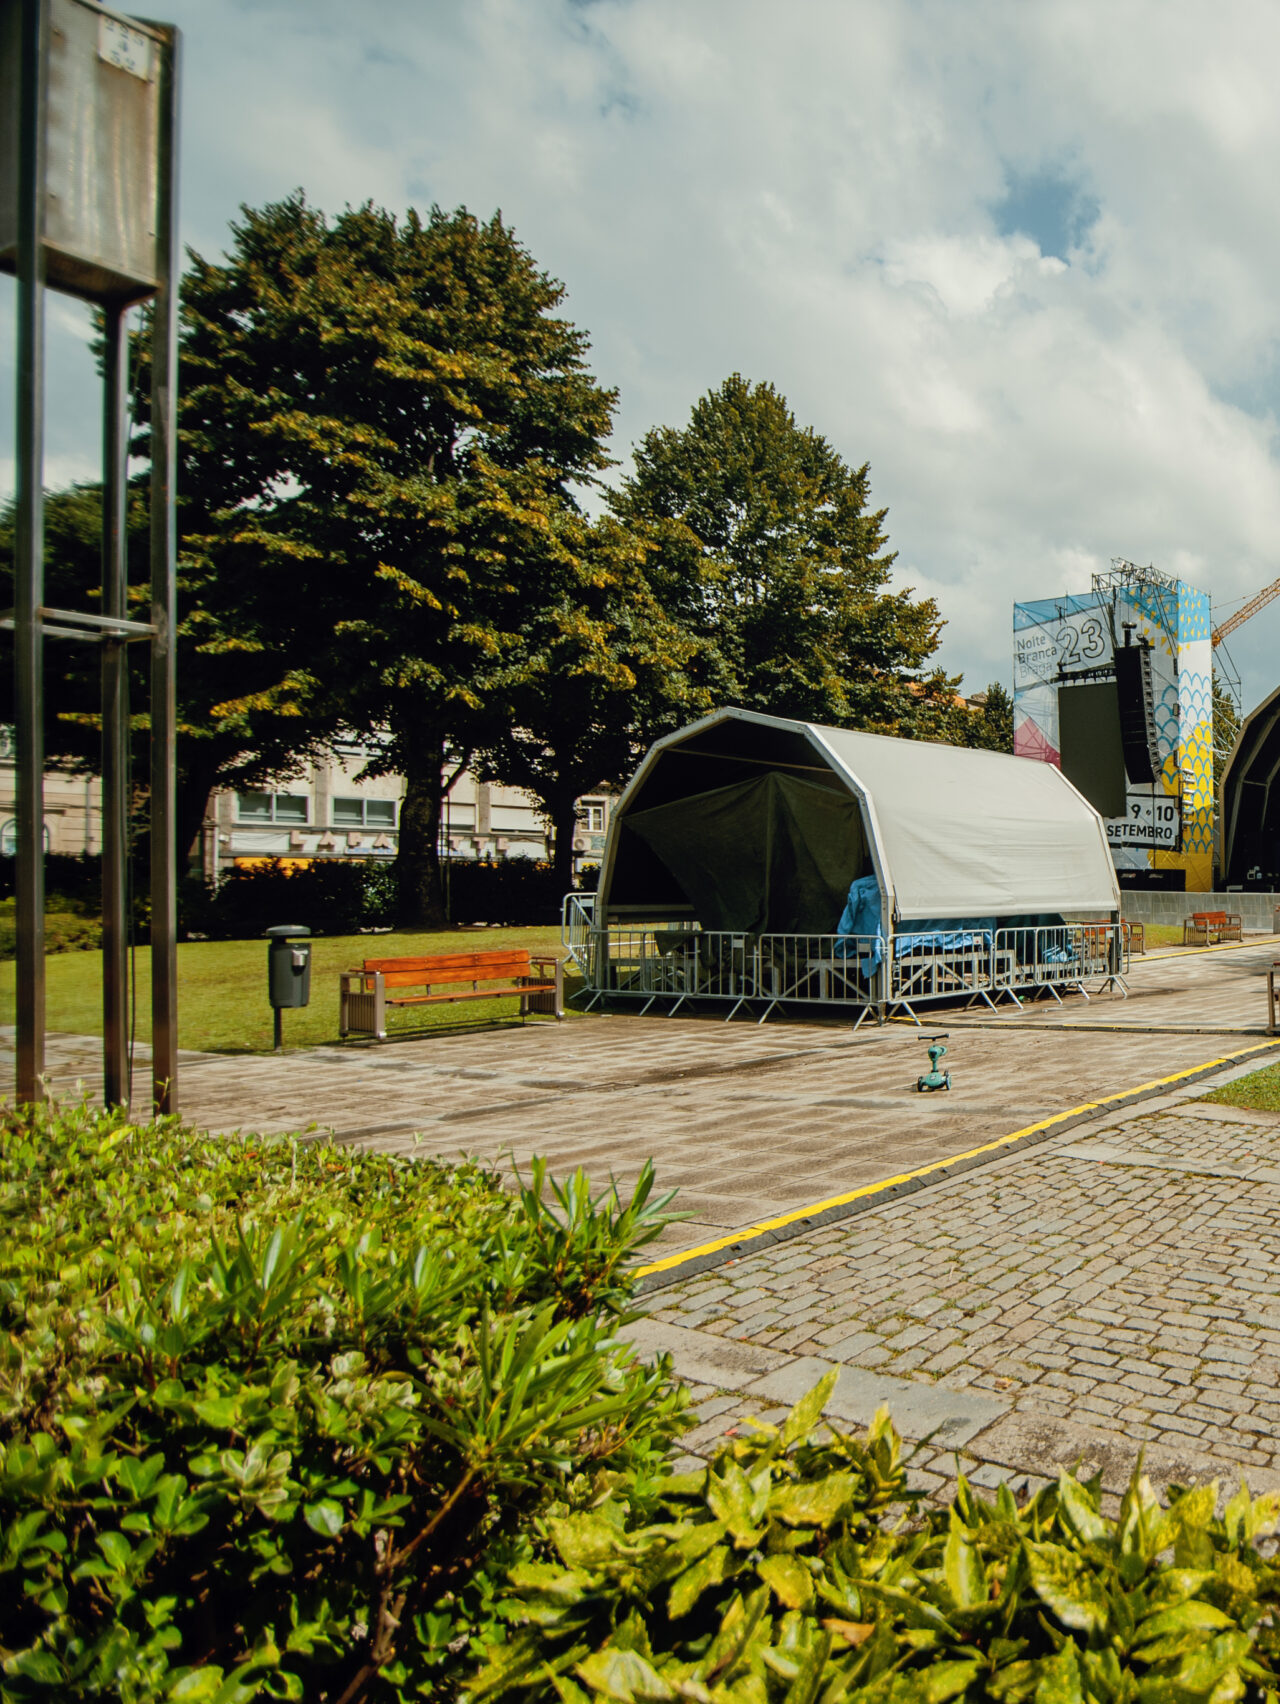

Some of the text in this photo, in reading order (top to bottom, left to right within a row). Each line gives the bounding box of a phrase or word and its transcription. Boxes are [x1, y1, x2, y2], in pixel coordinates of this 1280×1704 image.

[1017, 635, 1046, 651] Noite
[1056, 618, 1105, 666] 23
[1017, 646, 1057, 664] Branca
[1020, 662, 1053, 678] Braga
[1131, 804, 1174, 822] 9 10
[1107, 824, 1173, 839] SETEMBRO
